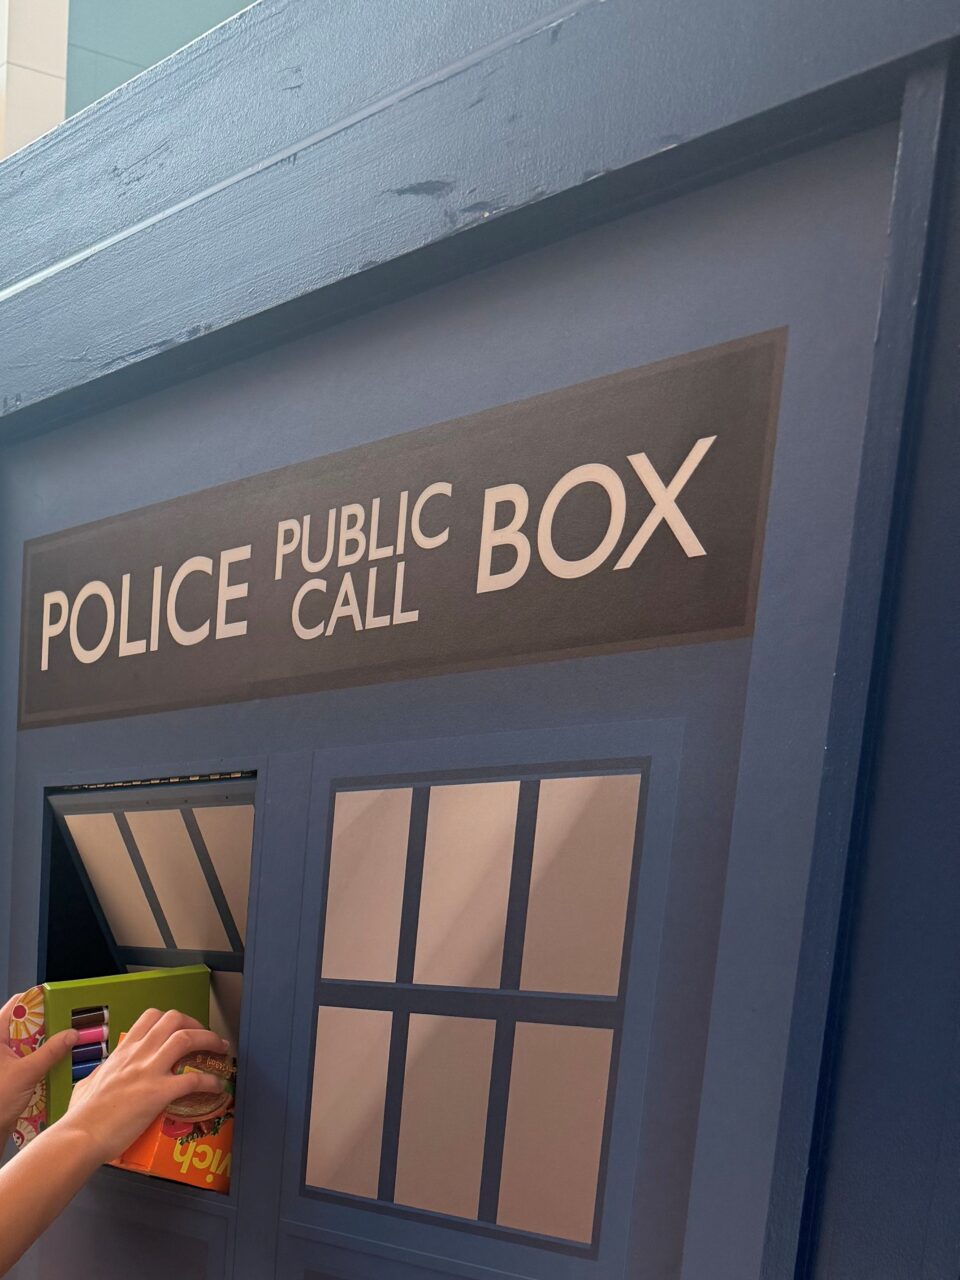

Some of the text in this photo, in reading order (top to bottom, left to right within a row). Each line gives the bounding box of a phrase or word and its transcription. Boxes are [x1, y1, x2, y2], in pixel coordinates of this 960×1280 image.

[275, 482, 452, 580] PUBLIC
[477, 435, 718, 594] BOX
[40, 544, 252, 671] POLICE
[292, 561, 419, 640] CALL
